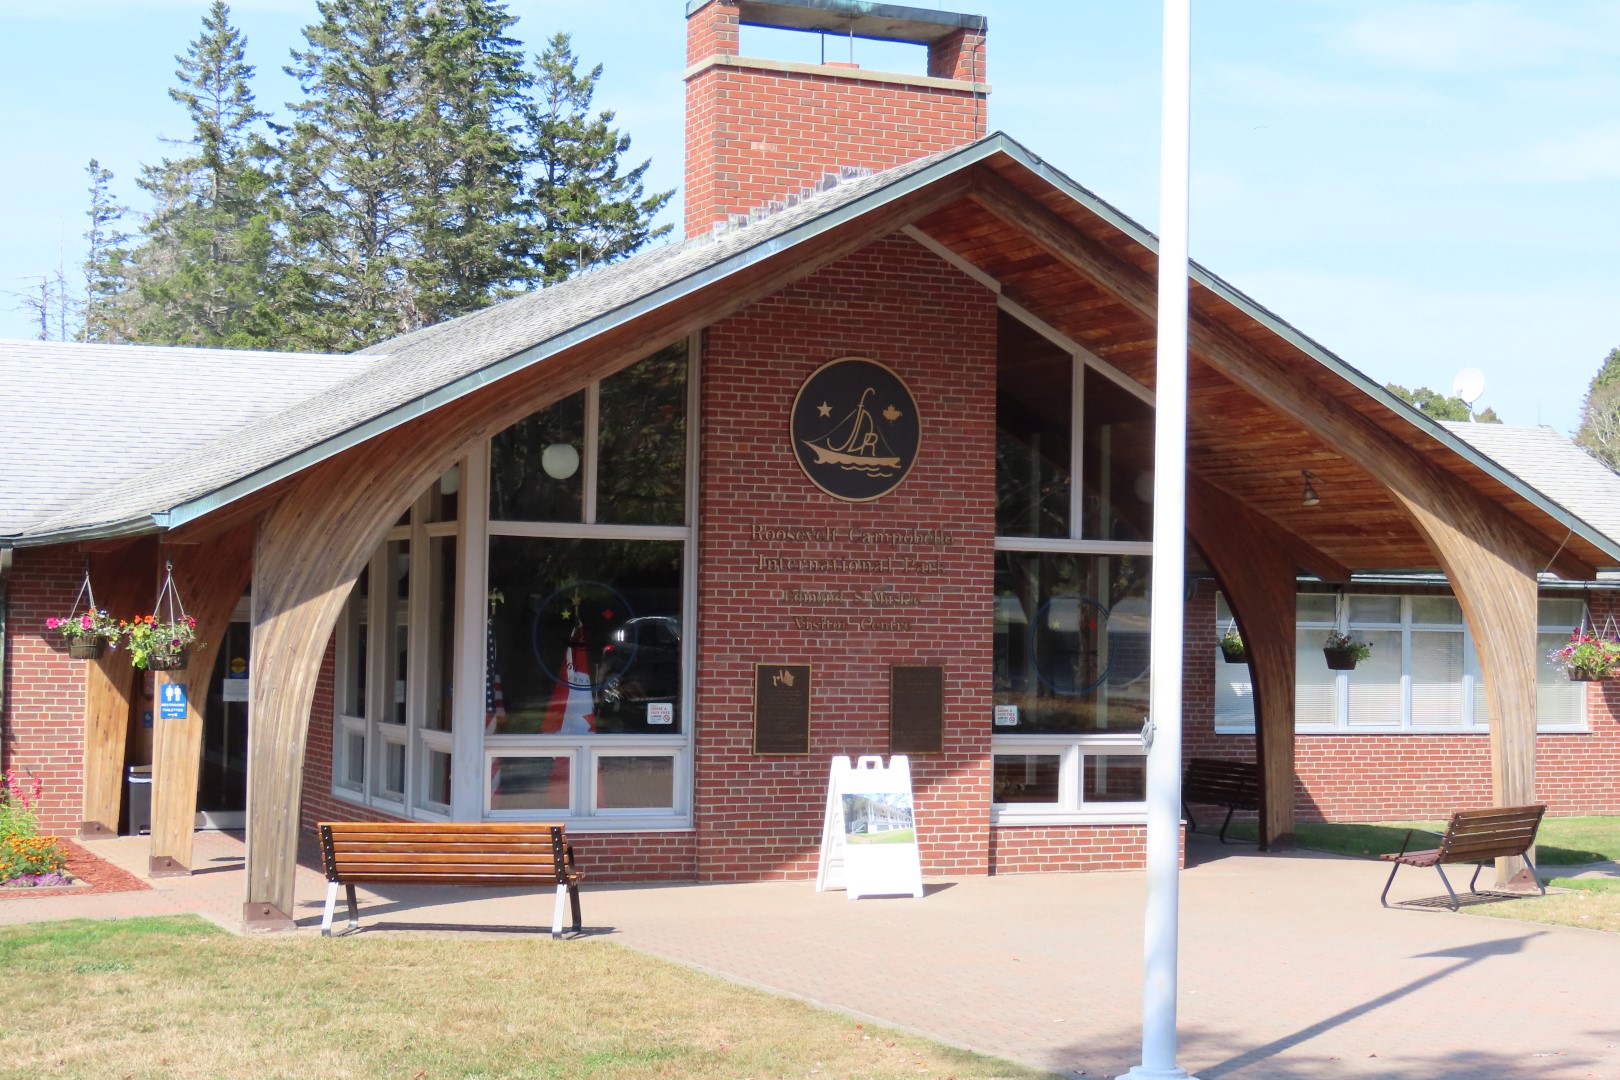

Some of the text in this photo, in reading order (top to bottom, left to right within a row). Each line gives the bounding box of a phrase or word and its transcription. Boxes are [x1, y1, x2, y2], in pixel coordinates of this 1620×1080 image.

[751, 525, 954, 547] Roosevelt Campobello
[758, 553, 947, 574] International Park
[782, 590, 843, 603] Edmund
[872, 591, 920, 605] Muskie
[793, 616, 912, 632] Visitor Centre
